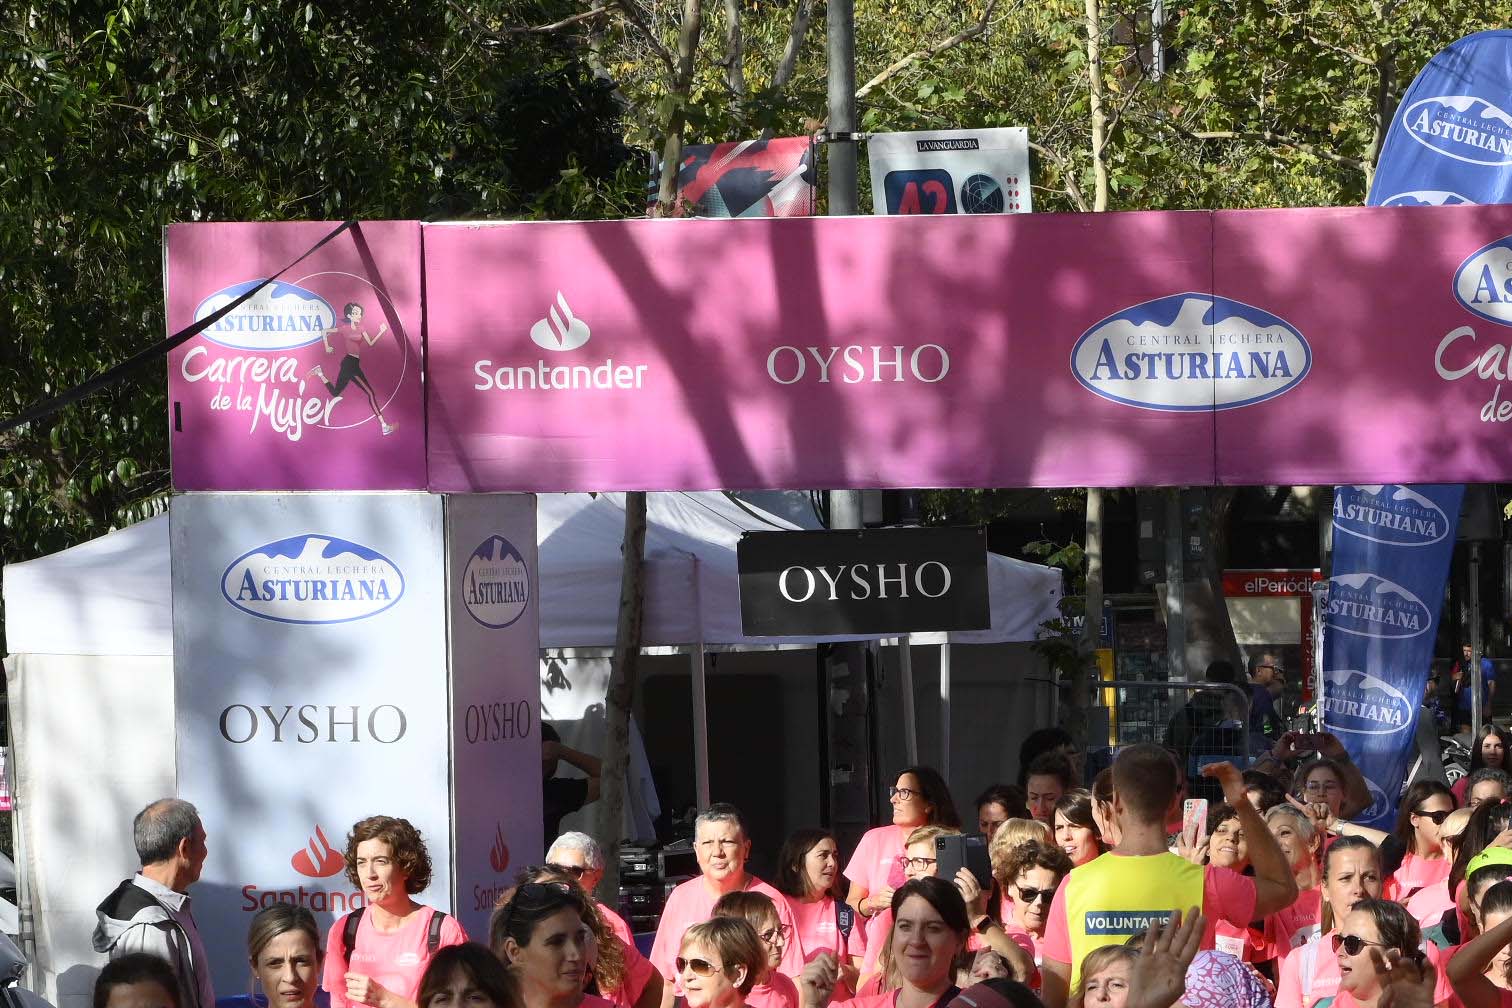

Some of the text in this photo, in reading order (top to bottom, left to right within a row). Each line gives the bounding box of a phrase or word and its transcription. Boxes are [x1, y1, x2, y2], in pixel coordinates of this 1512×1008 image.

[1126, 333, 1284, 346] CENTRAL LECHERA
[181, 345, 298, 383] Carrera
[475, 359, 648, 390] Santander
[766, 344, 950, 384] OYSHO
[1090, 338, 1293, 381] ASTURIANA
[210, 380, 343, 441] de la Mujer
[1332, 493, 1438, 538] ASTURIANA
[236, 567, 391, 602] ASTURIANA
[264, 565, 321, 575] CENTRAL
[467, 570, 525, 605] ASTURIANA
[779, 560, 952, 602] OYSHO
[219, 704, 407, 744] OYSHO
[465, 700, 531, 744] OYSHO
[242, 884, 370, 912] Santand
